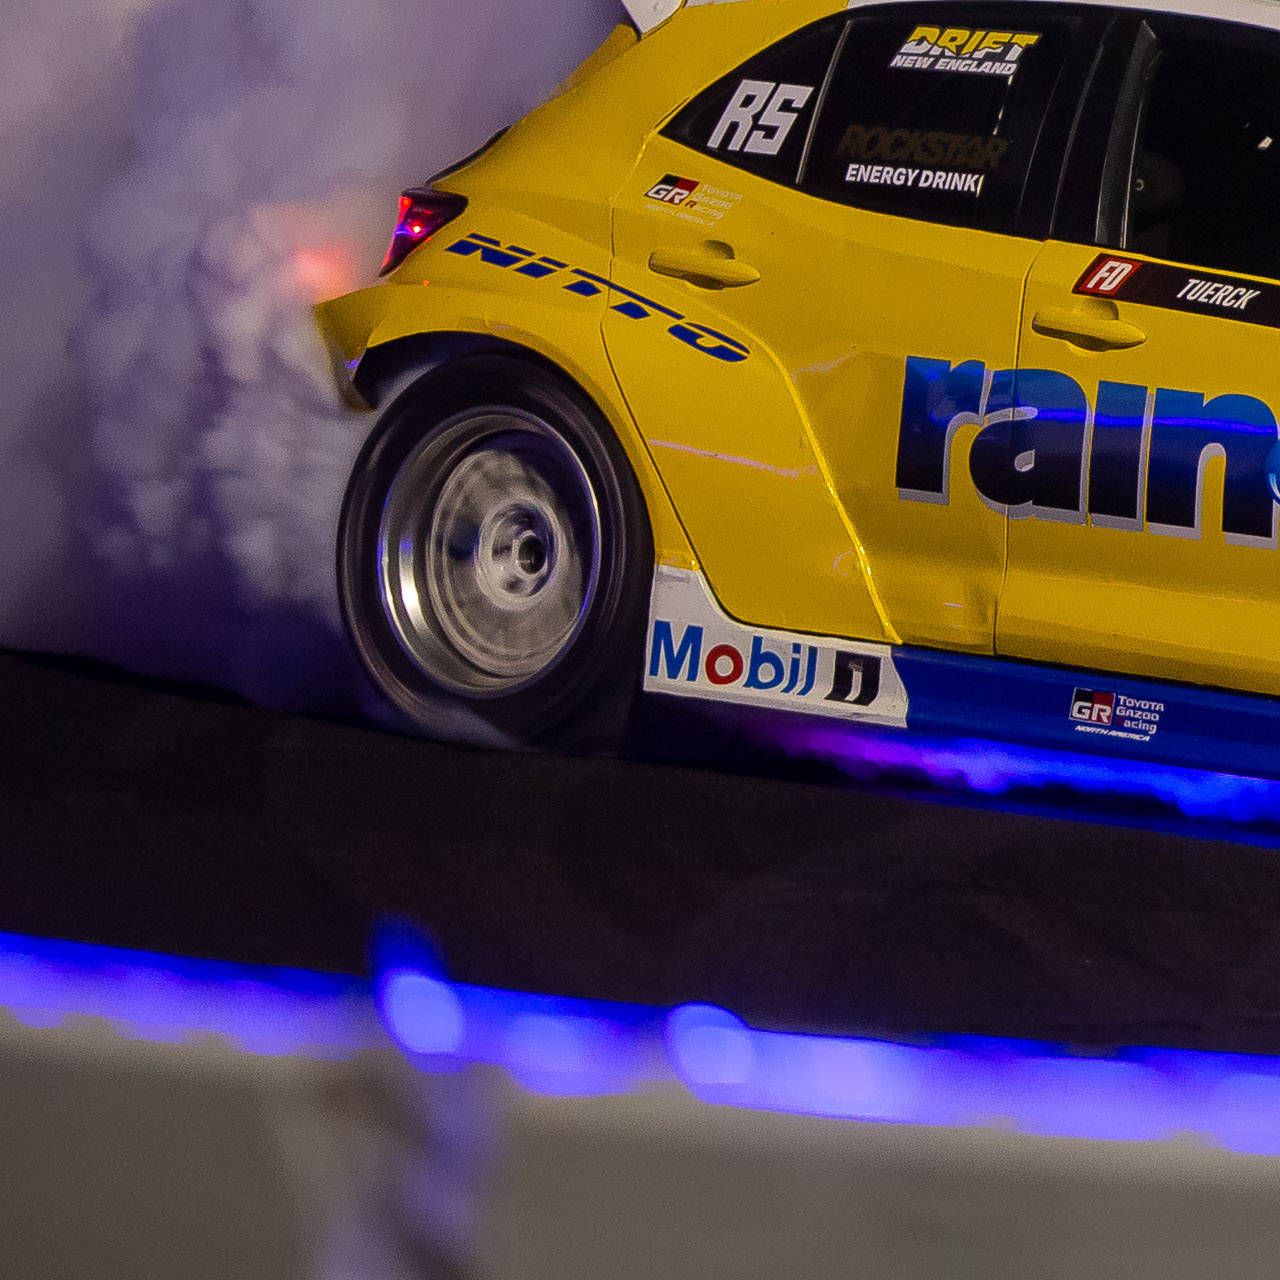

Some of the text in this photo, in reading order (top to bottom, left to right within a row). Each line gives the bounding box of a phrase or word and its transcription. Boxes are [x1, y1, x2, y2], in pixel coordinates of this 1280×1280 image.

[901, 26, 1040, 61] DRIFT
[890, 55, 1017, 75] NEW ENGLAND
[707, 79, 814, 155] RS
[846, 163, 920, 187] ENERGY
[646, 184, 690, 205] GR
[1086, 261, 1126, 291] FD
[1176, 277, 1261, 310] TUERCK
[650, 620, 817, 696] Mobil
[1072, 701, 1112, 723] GR
[1115, 705, 1160, 721] GAZOO
[1117, 694, 1165, 712] TOYOTA
[1075, 724, 1151, 742] NORTH AMERICA
[1116, 718, 1158, 734] acing
